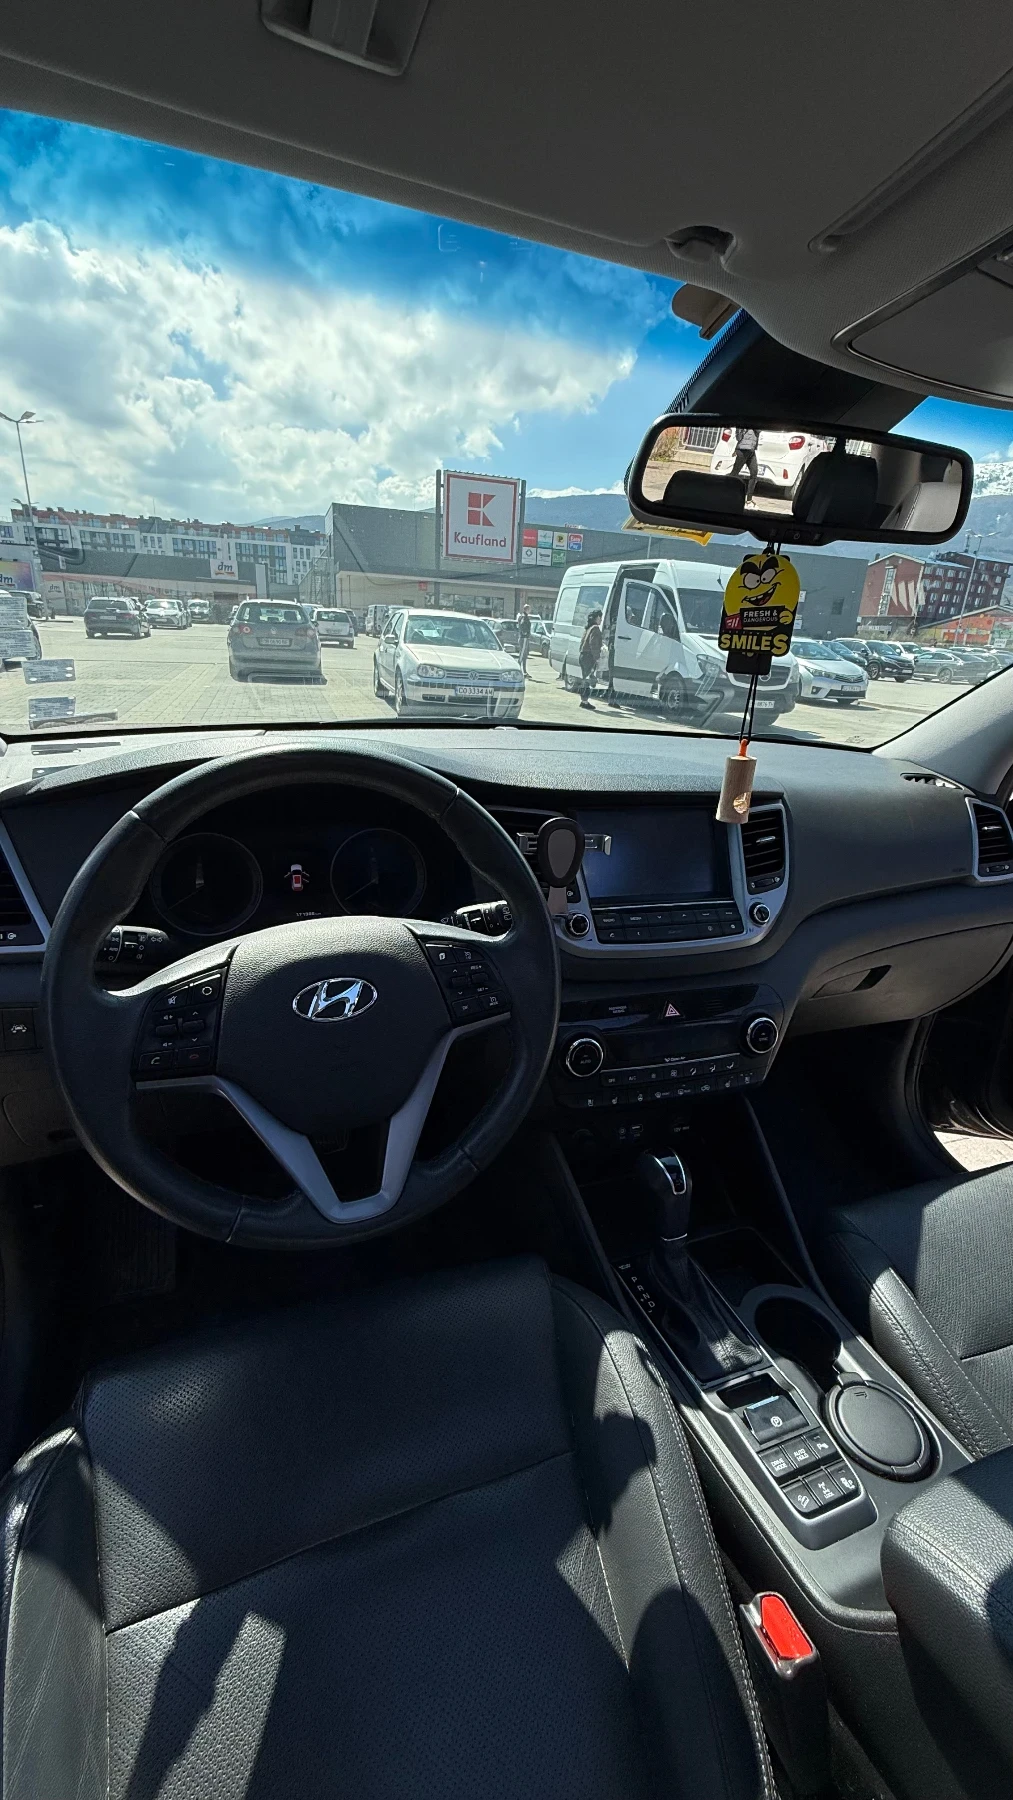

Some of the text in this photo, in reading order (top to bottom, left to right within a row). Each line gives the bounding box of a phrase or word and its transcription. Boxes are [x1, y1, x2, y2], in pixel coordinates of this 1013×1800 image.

[454, 531, 507, 548] Kaufland
[218, 561, 233, 571] dm
[720, 633, 788, 655] SMILES
[793, 1448, 806, 1457] AUTO
[796, 1453, 809, 1462] HOLD
[771, 1458, 785, 1468] DRIVE
[774, 1463, 788, 1472] MODE
